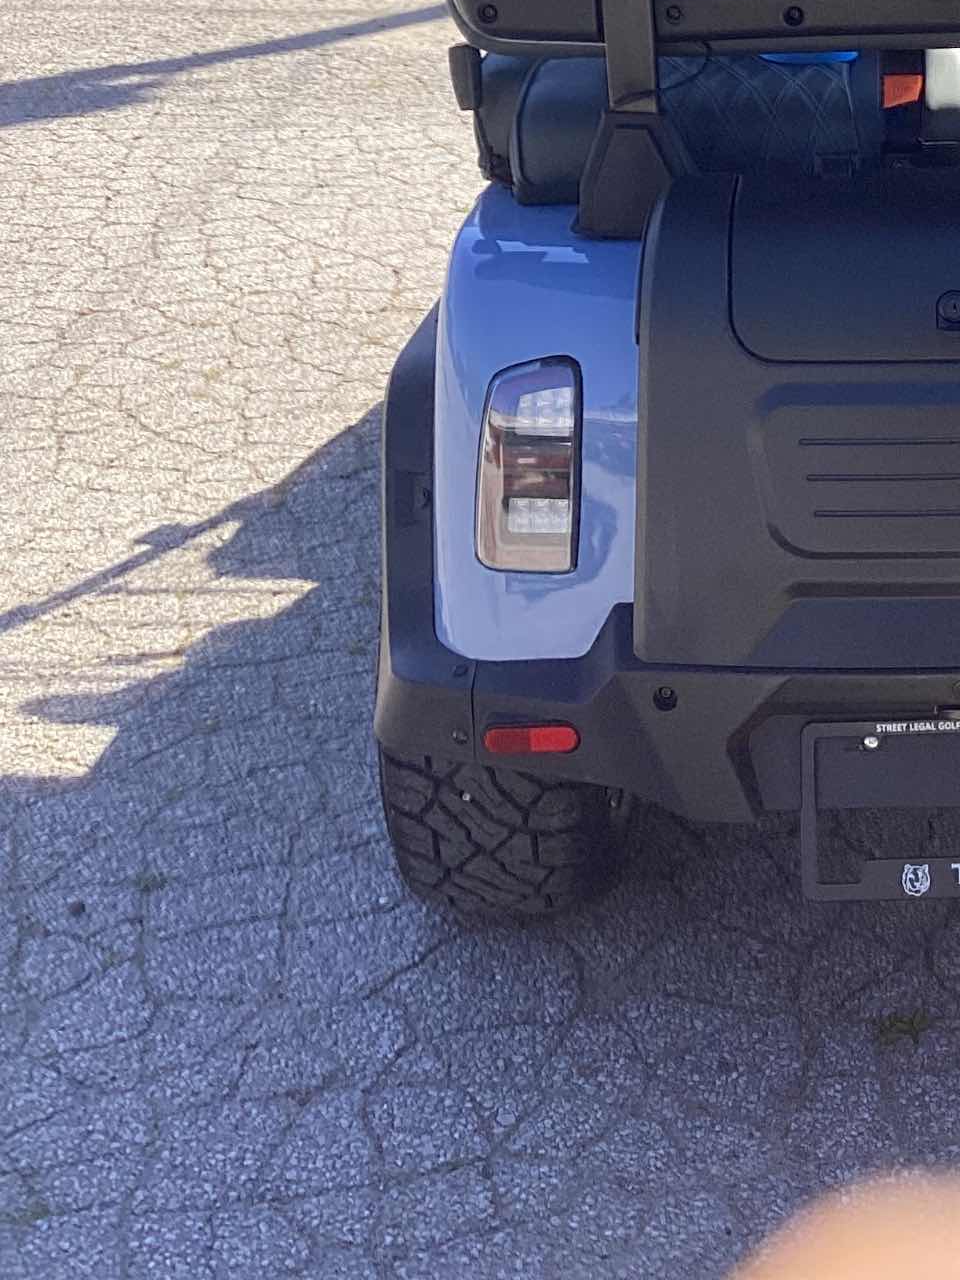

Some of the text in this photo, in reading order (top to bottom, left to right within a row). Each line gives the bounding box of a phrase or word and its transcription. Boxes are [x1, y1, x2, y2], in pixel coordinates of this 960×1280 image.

[876, 723, 907, 733] STREET
[909, 721, 937, 732] LEGAL
[938, 721, 960, 731] GOLF
